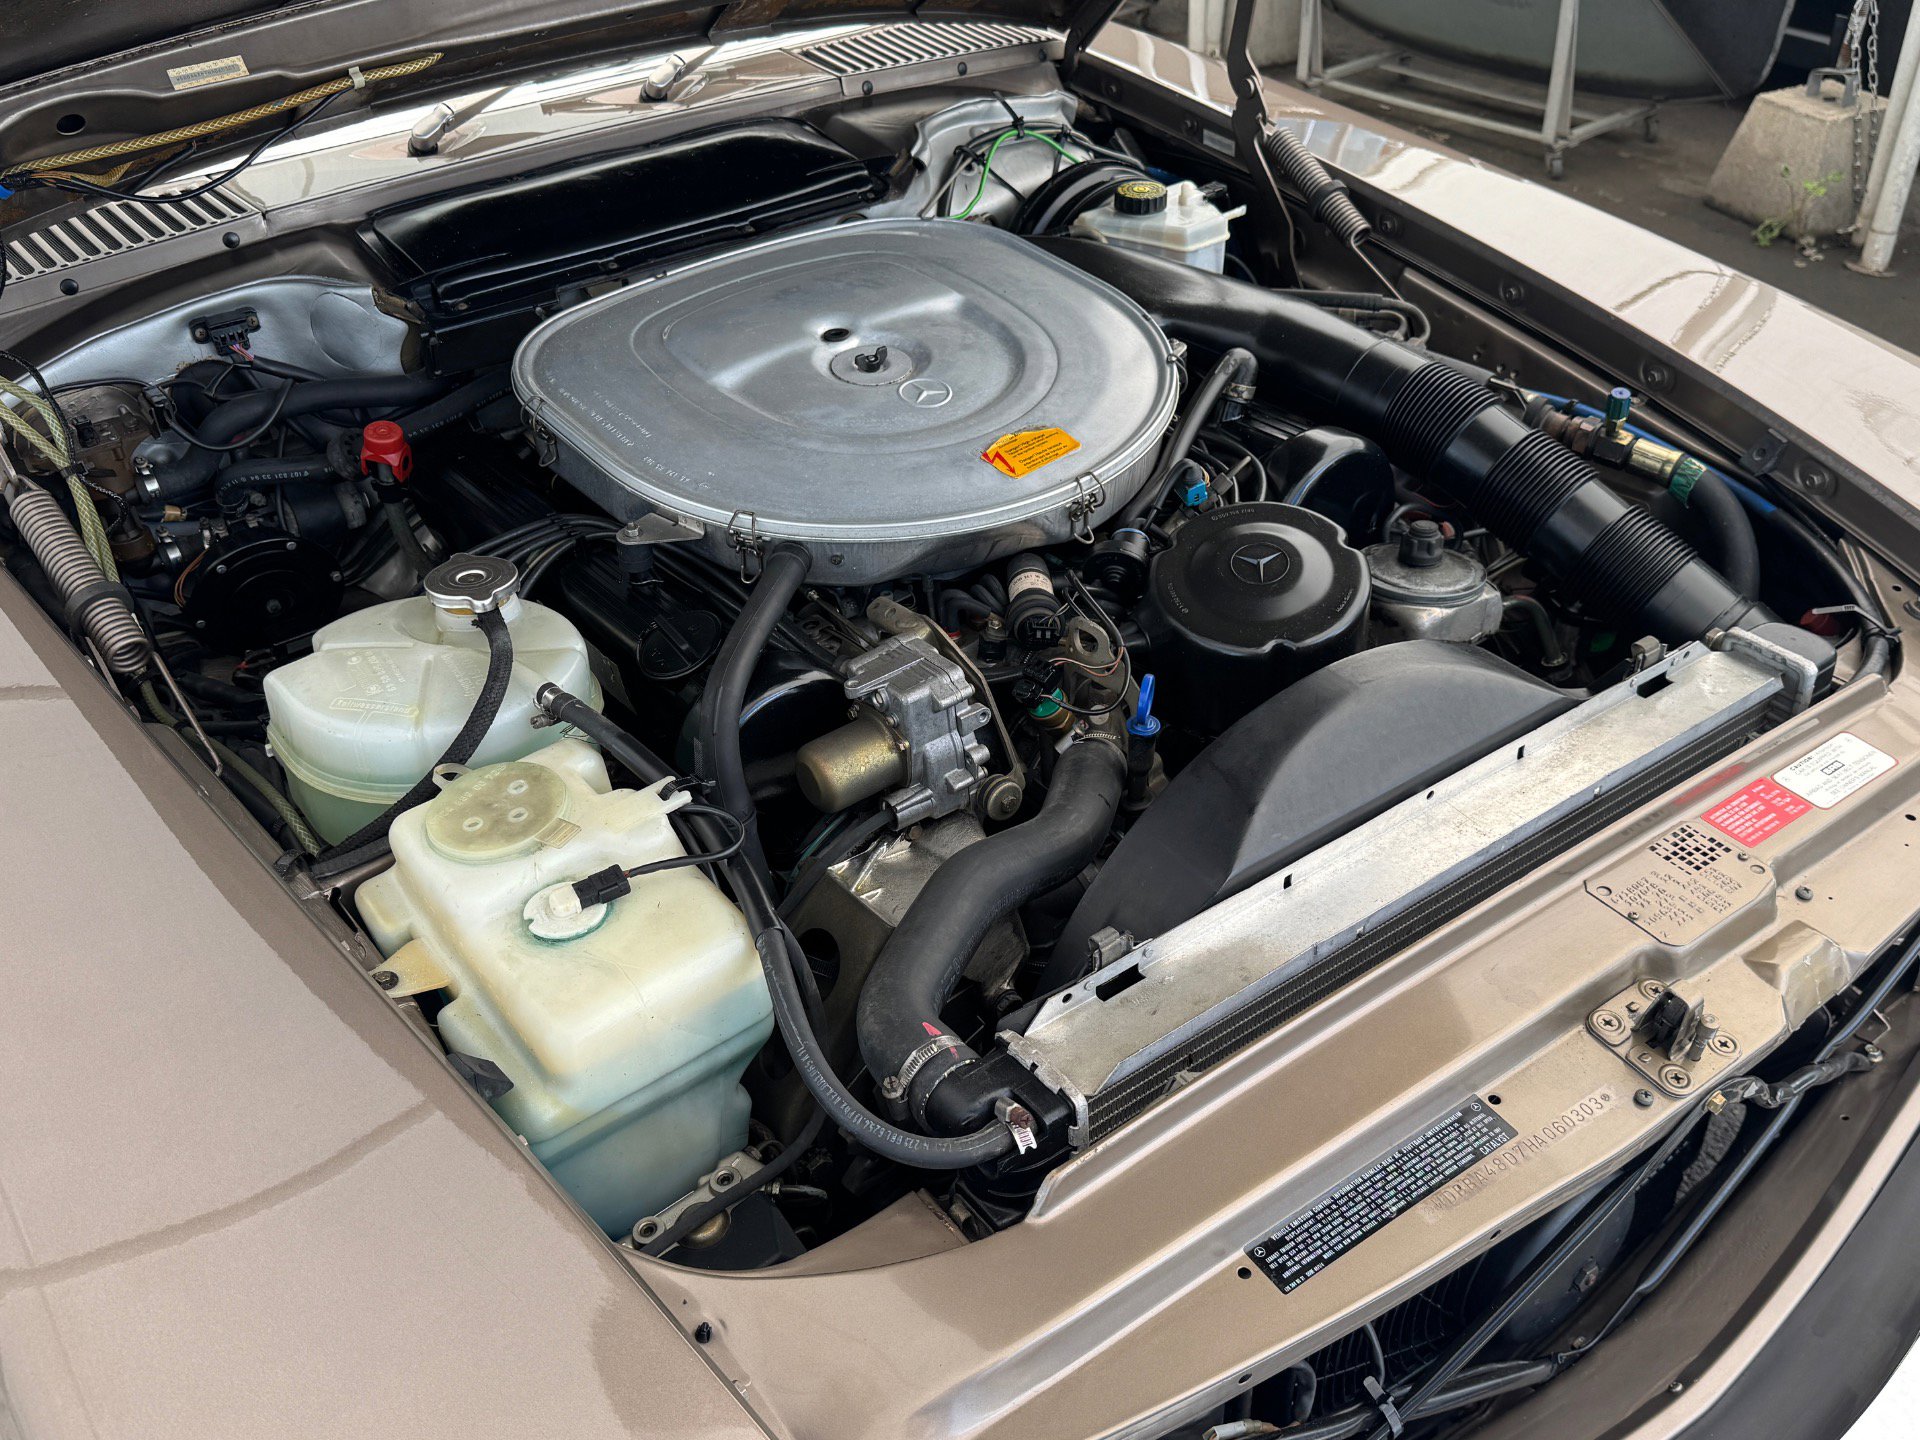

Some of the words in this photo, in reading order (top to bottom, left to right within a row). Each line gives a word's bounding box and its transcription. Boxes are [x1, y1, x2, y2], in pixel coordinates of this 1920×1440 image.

[1479, 1132, 1510, 1155] CATALYST
[1271, 1225, 1292, 1241] VEHICLE
[1290, 1211, 1314, 1228] EMISSION
[1312, 1197, 1334, 1213] CONTROL
[1332, 1177, 1364, 1199] INFORMATION
